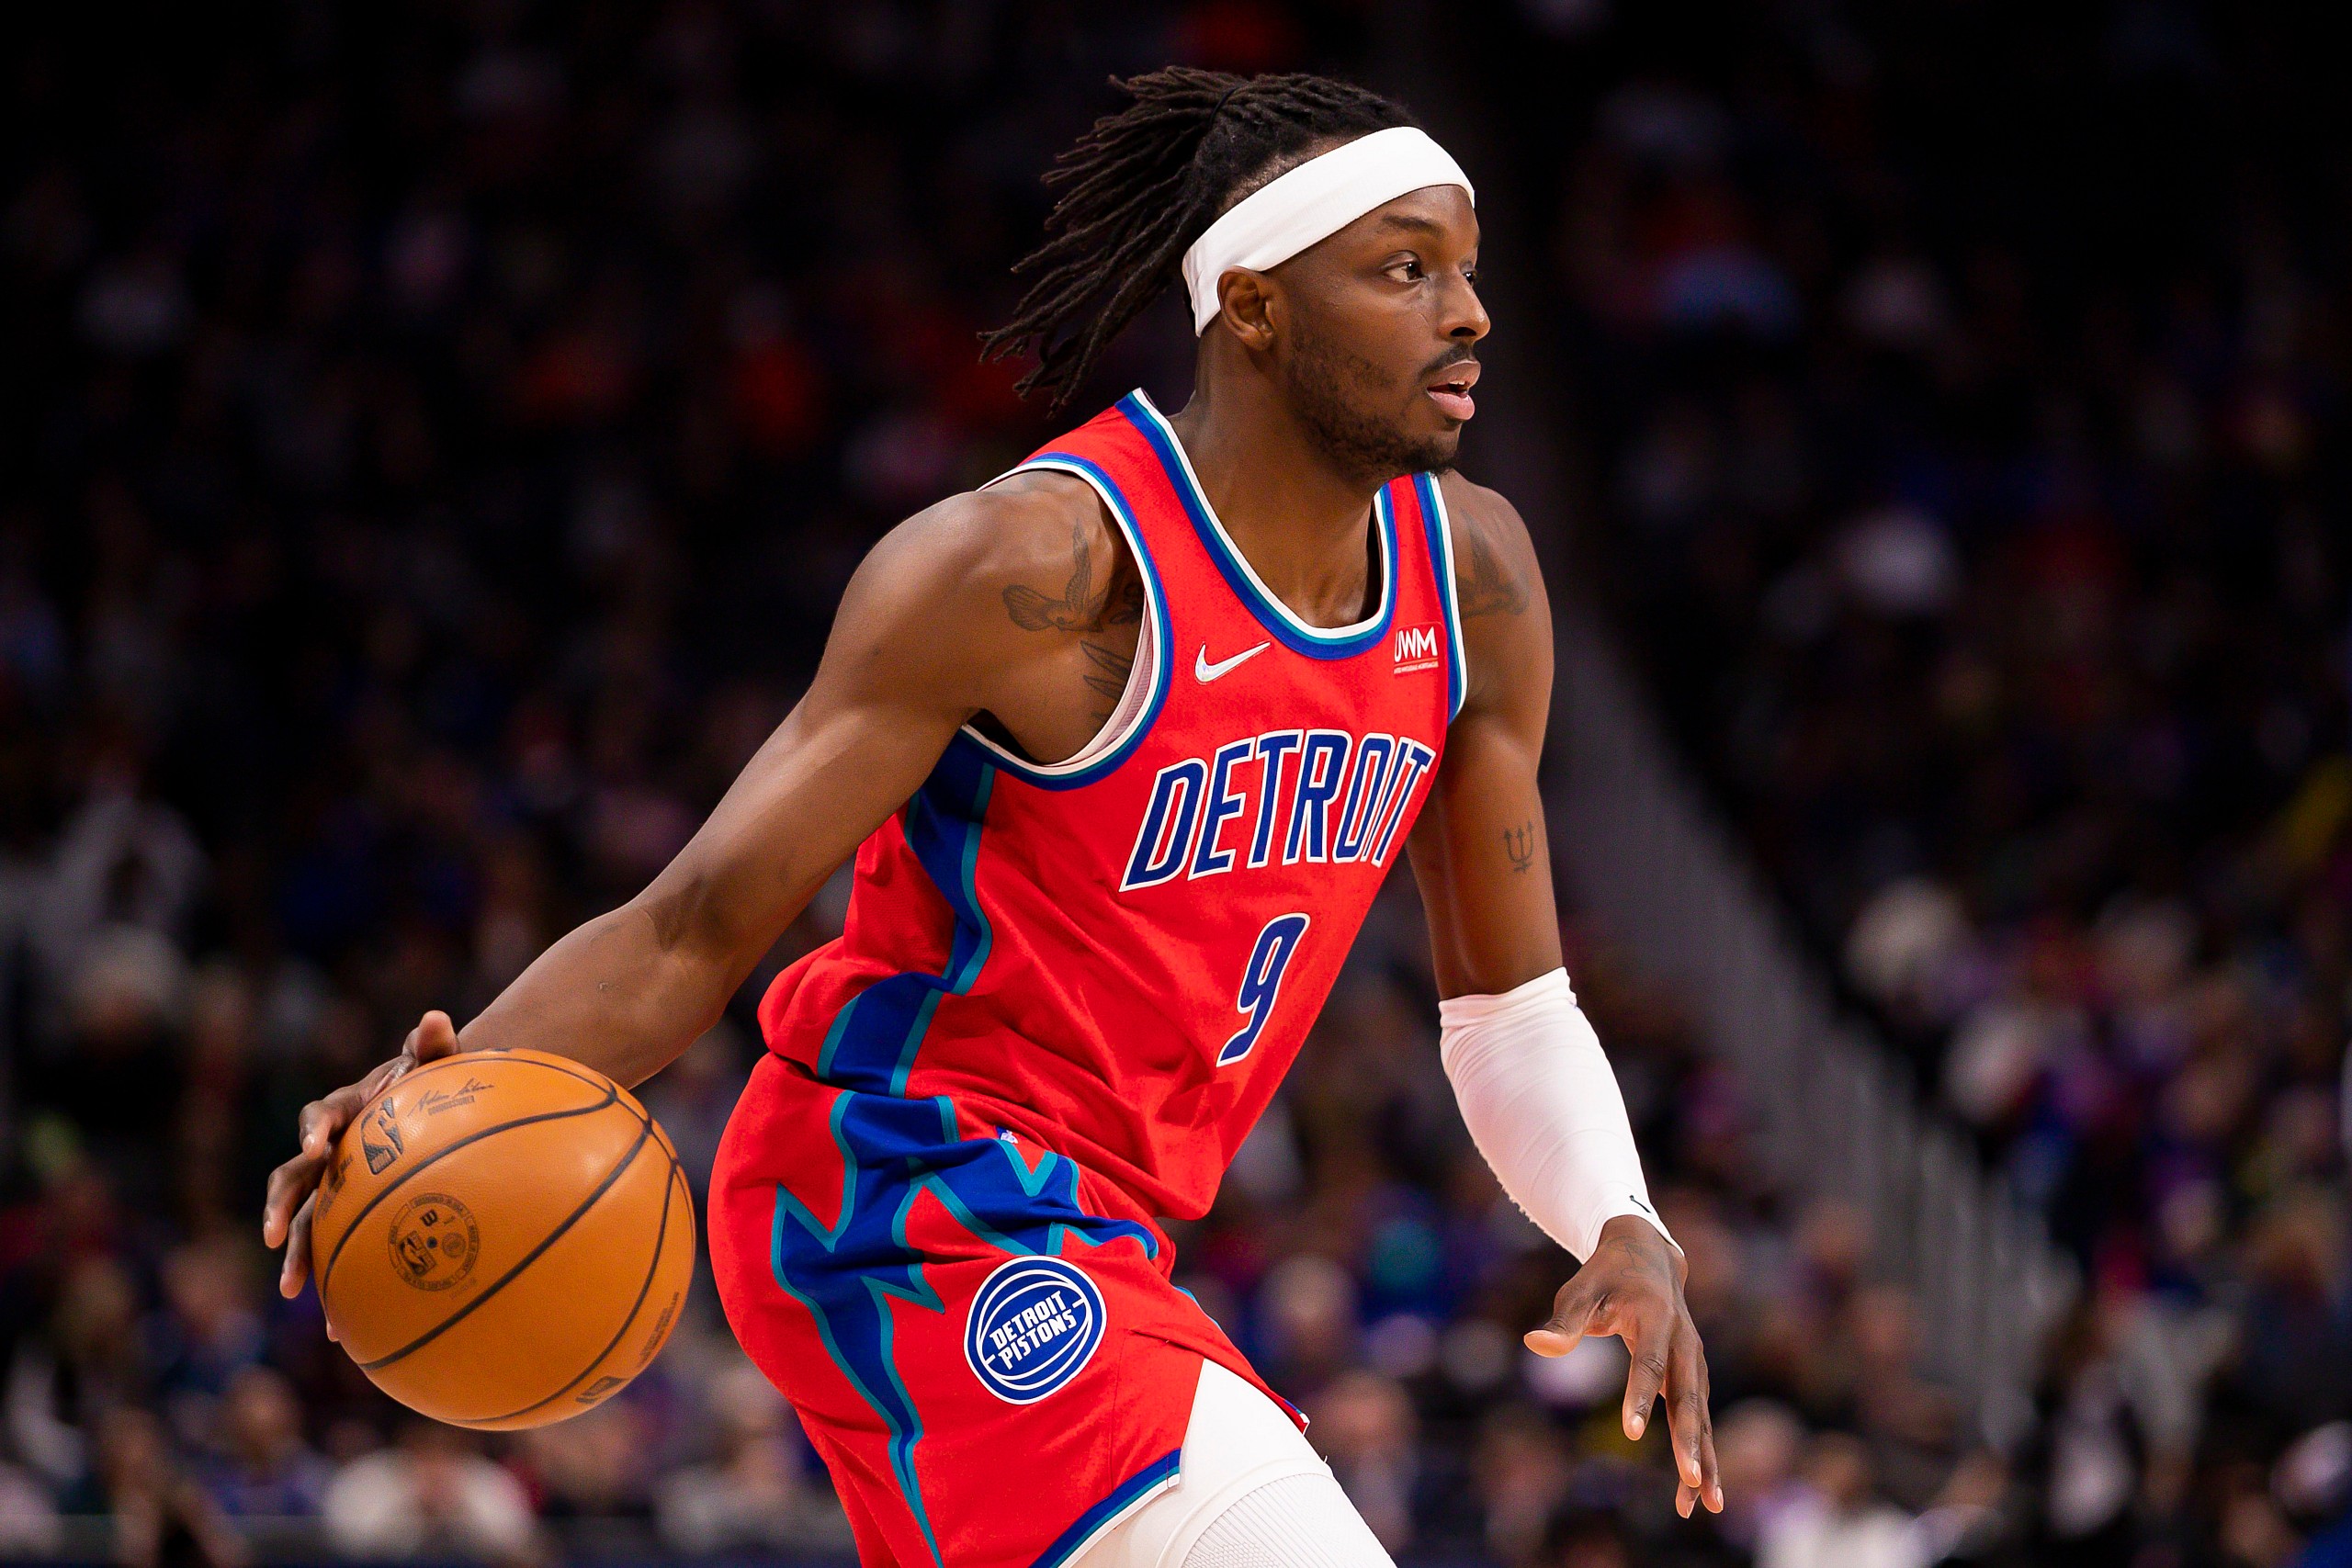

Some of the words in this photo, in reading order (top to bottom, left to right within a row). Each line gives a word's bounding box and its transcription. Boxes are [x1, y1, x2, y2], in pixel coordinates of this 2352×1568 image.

[1119, 728, 1436, 893] DETROIT
[1216, 912, 1311, 1068] 9
[989, 1290, 1067, 1350] DETROIT
[998, 1309, 1078, 1371] PISTONS
